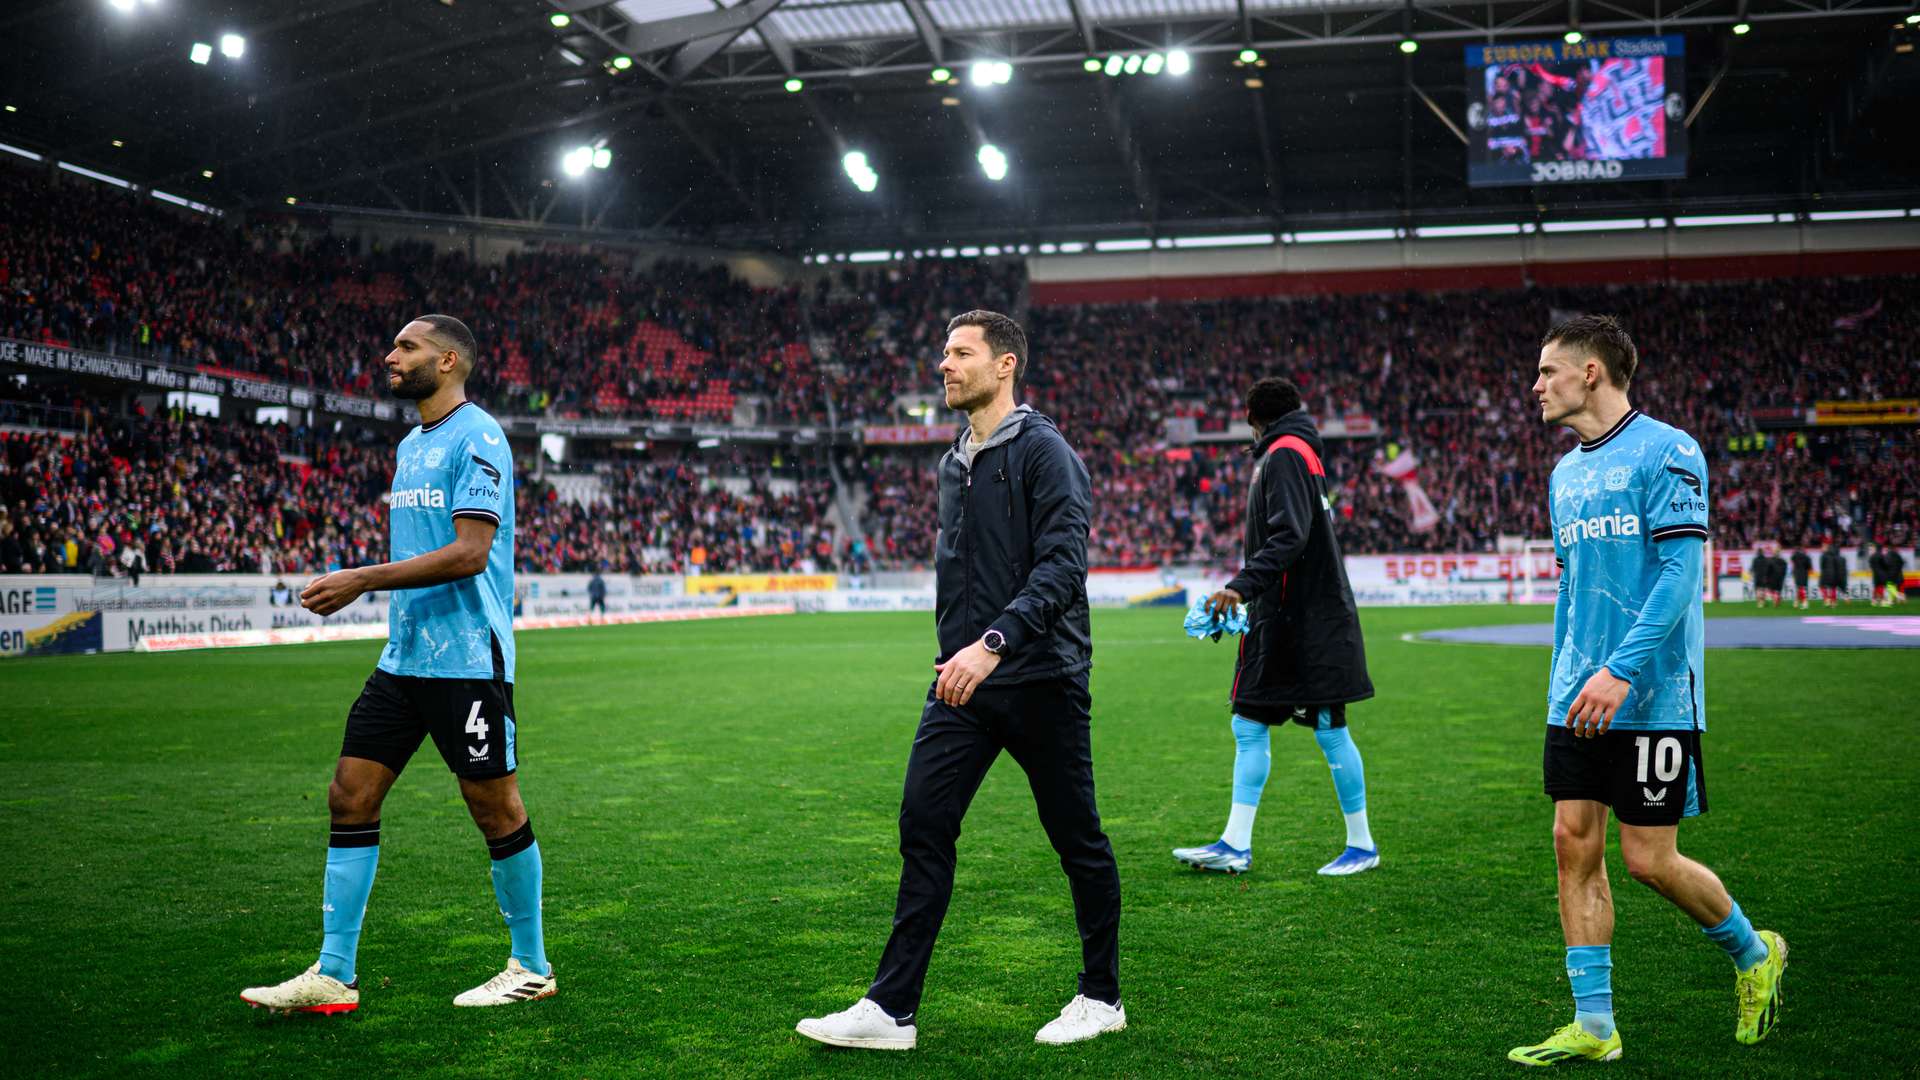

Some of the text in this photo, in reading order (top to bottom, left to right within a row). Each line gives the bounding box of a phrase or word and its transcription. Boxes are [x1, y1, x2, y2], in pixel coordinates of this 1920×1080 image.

[1483, 39, 1667, 64] EUROPA PARK Stadion
[1531, 161, 1624, 181] JOBRAD
[24, 346, 55, 368] MADE
[57, 351, 69, 369] IM
[71, 353, 142, 382] SCHWARZWALD
[147, 366, 176, 388] wiha
[189, 372, 216, 394] wiha
[468, 486, 499, 500] trive
[1670, 498, 1705, 513] trive
[465, 700, 489, 740] 4
[1635, 736, 1682, 782] 10
